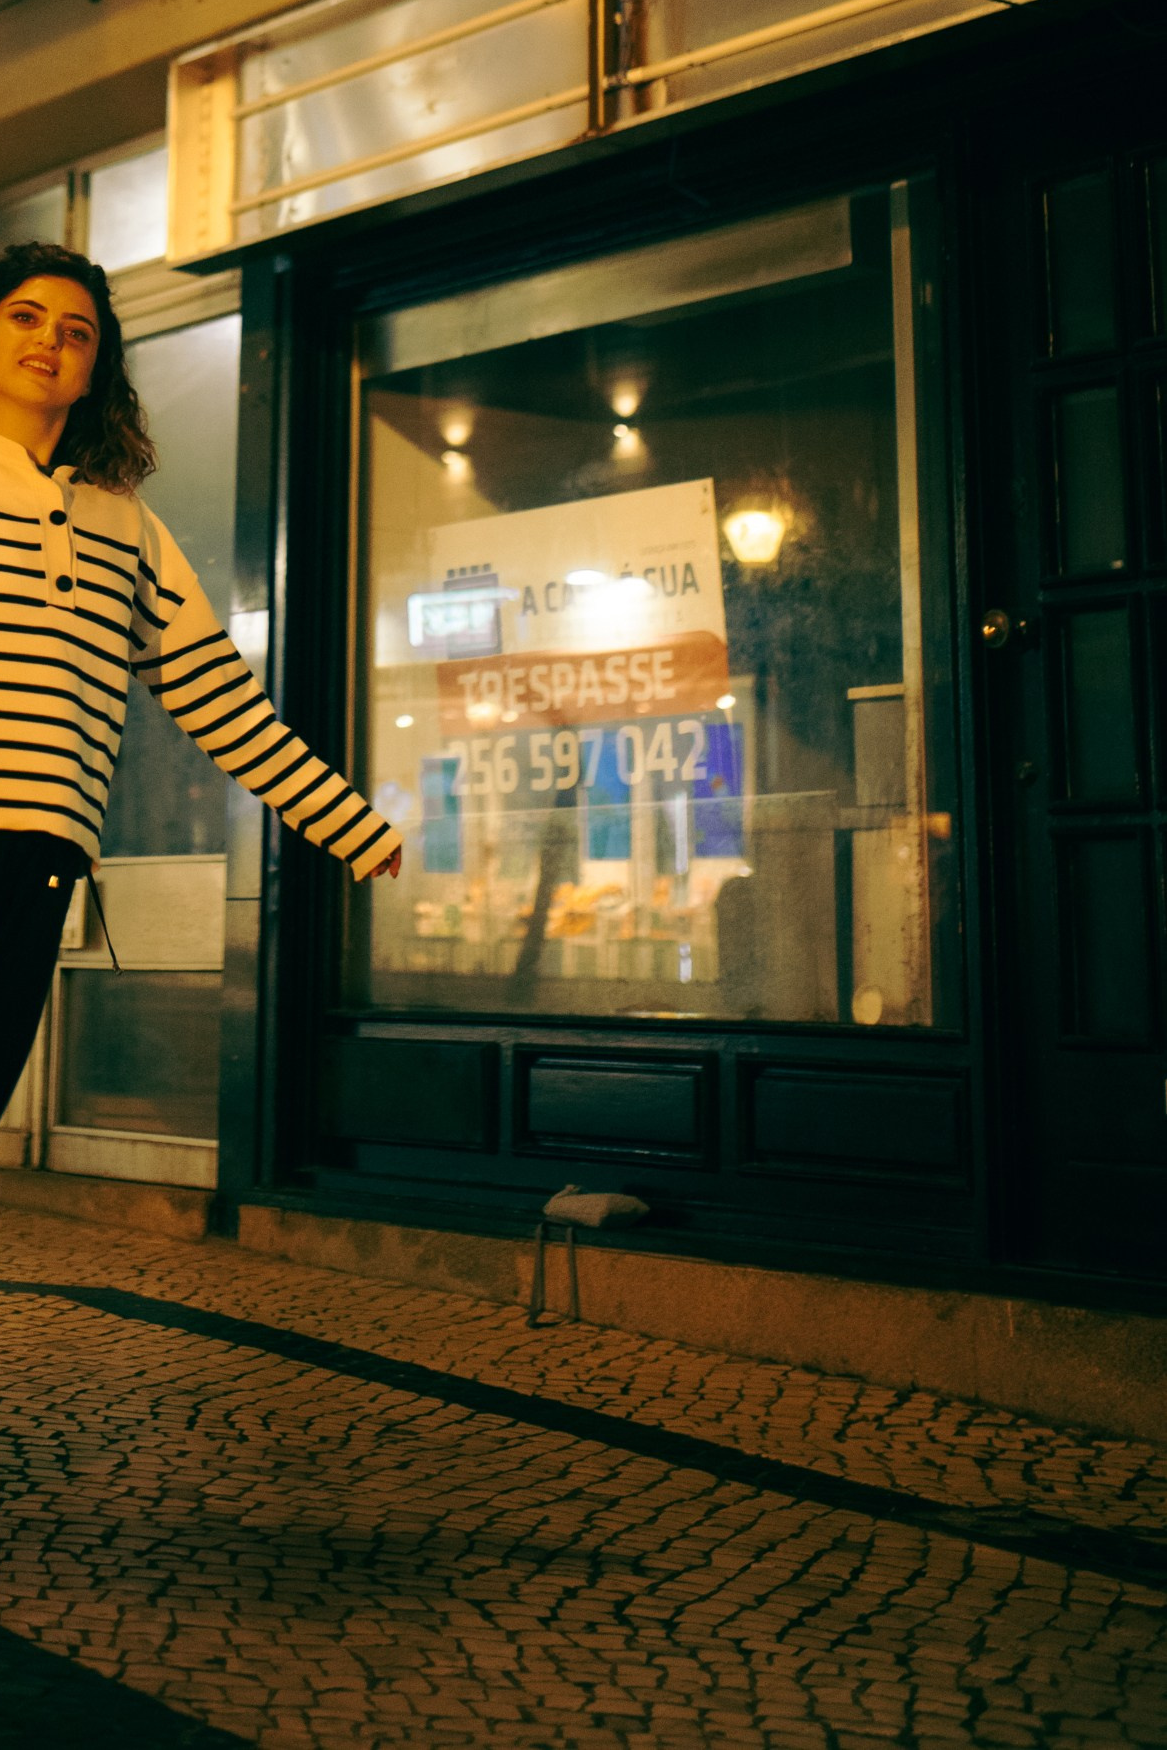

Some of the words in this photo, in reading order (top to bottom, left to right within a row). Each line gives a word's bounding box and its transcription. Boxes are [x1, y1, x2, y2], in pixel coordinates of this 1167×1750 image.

[520, 585, 538, 617] A
[643, 562, 700, 598] SUA
[457, 650, 676, 716] TRESPASSE
[448, 735, 520, 796] 256
[529, 729, 604, 791] 597
[616, 719, 708, 786] 042
